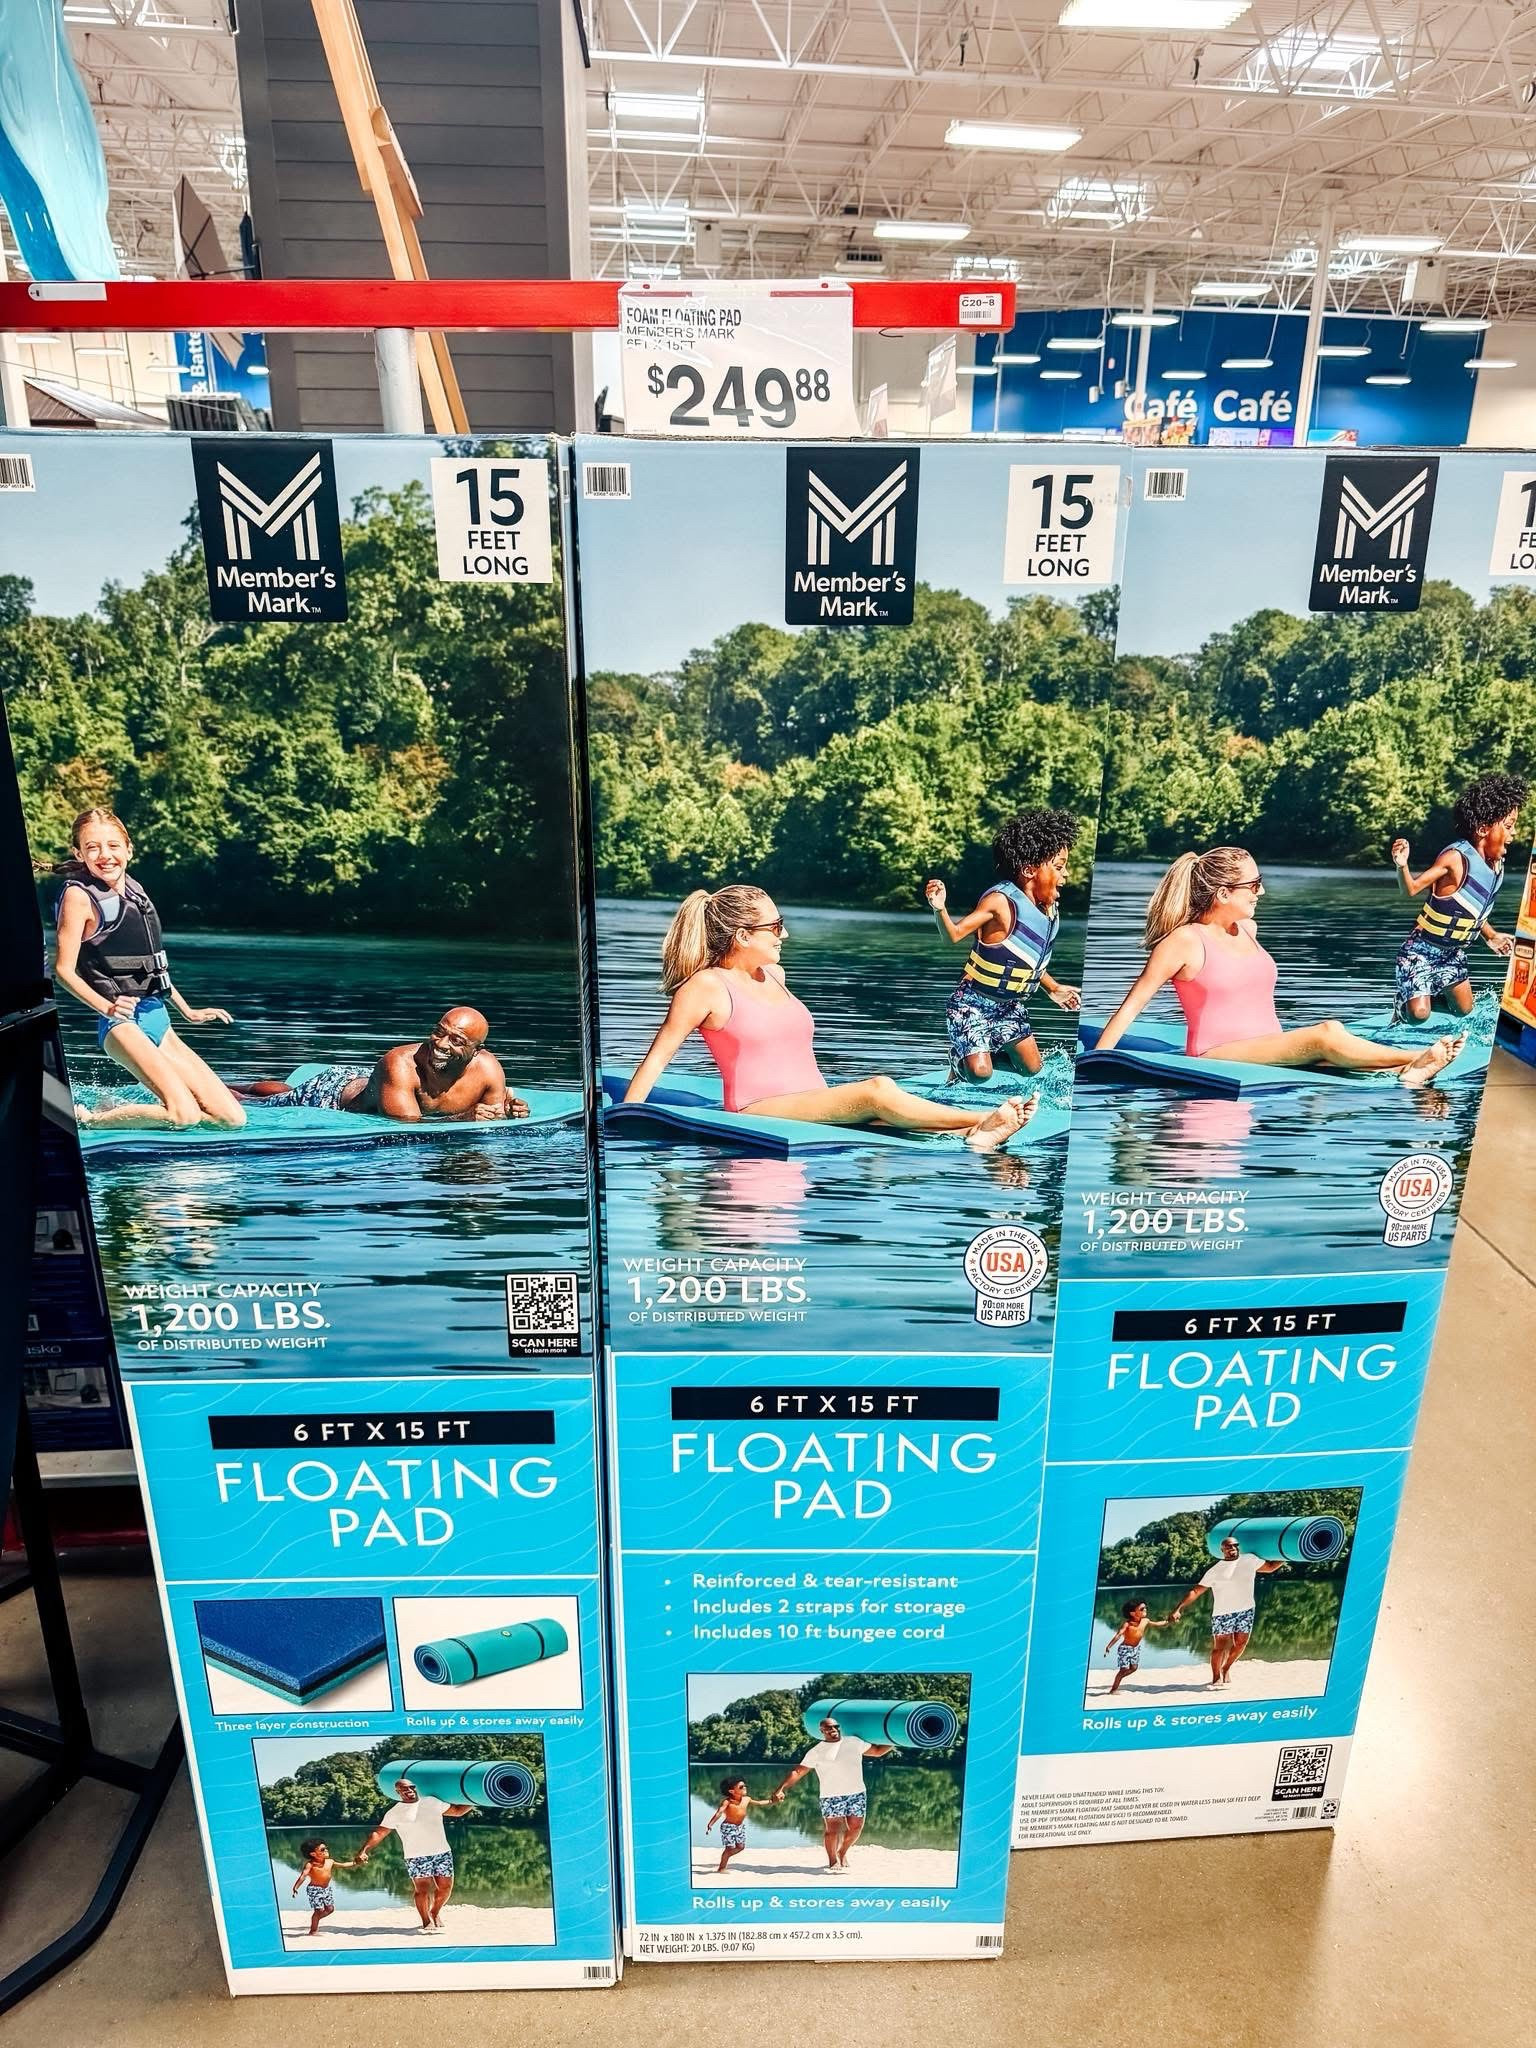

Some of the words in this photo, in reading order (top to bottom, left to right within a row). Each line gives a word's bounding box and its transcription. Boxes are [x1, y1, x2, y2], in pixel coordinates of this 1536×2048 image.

[962, 299, 995, 307] C20-8
[627, 307, 658, 325] FOAM
[720, 309, 741, 327] PAD
[627, 326, 694, 338] MEMBER'S
[698, 328, 735, 339] MARK
[1124, 390, 1197, 421] Café
[1213, 389, 1292, 422] Café
[456, 467, 525, 526] 15
[1031, 474, 1094, 530] 15
[468, 530, 521, 551] FEET
[1035, 534, 1086, 553] FEET
[463, 555, 529, 576] LONG
[1027, 557, 1090, 577] LONG
[1510, 553, 1536, 570] LO
[217, 565, 336, 589] Member's
[793, 570, 906, 593] Member's
[1319, 563, 1417, 583] Member's
[1389, 1161, 1409, 1182] MADE
[1411, 1158, 1420, 1166] IN
[1422, 1158, 1438, 1167] THE
[1436, 1165, 1447, 1180] USA
[1399, 1178, 1433, 1197] USA
[1080, 1191, 1156, 1206] WEIGHT
[1161, 1190, 1250, 1205] CAPACITY
[1384, 1194, 1409, 1217] FACTORY
[1411, 1191, 1446, 1217] CERTIFIED
[1083, 1208, 1173, 1240] 1,200
[1185, 1207, 1249, 1234] LBS.
[972, 1233, 994, 1255] MADE
[995, 1230, 1006, 1238] IN
[1009, 1230, 1027, 1241] THE
[1026, 1238, 1041, 1255] USA
[1080, 1241, 1099, 1252] OF
[1102, 1241, 1187, 1252] DISTRIBUTED
[1190, 1240, 1244, 1250] WEIGHT
[1388, 1231, 1400, 1242] US
[1400, 1230, 1427, 1241] PARTS
[623, 1257, 705, 1273] WEIGHT
[710, 1257, 807, 1273] CAPACITY
[986, 1252, 1026, 1273] USA
[122, 1283, 212, 1300] WEIGHT
[218, 1281, 320, 1298] CAPACITY
[970, 1268, 1002, 1295] FACTORY
[1003, 1268, 1042, 1295] CERTIFIED
[627, 1276, 727, 1310] 1,200
[740, 1276, 812, 1304] LBS.
[131, 1302, 239, 1338] 1,200
[252, 1300, 331, 1330] LBS.
[628, 1311, 648, 1322] OF
[652, 1311, 745, 1322] DISTRIBUTED
[748, 1311, 807, 1322] WEIGHT
[981, 1310, 993, 1321] US
[995, 1310, 1026, 1321] PARTS
[1185, 1318, 1198, 1334] 6
[1208, 1317, 1238, 1333] FT
[1246, 1316, 1263, 1333] X
[1272, 1315, 1297, 1332] 15
[1306, 1313, 1336, 1330] FT
[137, 1339, 160, 1351] OF
[163, 1338, 262, 1350] DISTRIBUTED
[266, 1337, 328, 1349] WEIGHT
[511, 1338, 545, 1348] SCAN
[547, 1338, 578, 1347] HERE
[1107, 1343, 1397, 1391] FLOATING
[750, 1395, 764, 1414] 6
[777, 1395, 809, 1413] FT
[819, 1395, 837, 1413] X
[848, 1395, 874, 1413] 15
[887, 1395, 919, 1413] FT
[1194, 1391, 1301, 1431] PAD
[293, 1423, 309, 1442] 6
[321, 1422, 355, 1441] FT
[366, 1421, 385, 1441] X
[395, 1420, 425, 1440] 15
[437, 1420, 471, 1440] FT
[672, 1431, 998, 1474] FLOATING
[215, 1456, 558, 1504] FLOATING
[774, 1479, 892, 1520] PAD
[329, 1506, 455, 1548] PAD
[692, 1573, 797, 1589] Reinforced
[803, 1574, 819, 1589] &
[824, 1575, 958, 1589] tear-resistant
[692, 1599, 772, 1615] Includes
[778, 1599, 790, 1614] 2
[795, 1600, 854, 1618] straps
[861, 1598, 888, 1614] for
[894, 1601, 966, 1618] storage
[693, 1624, 772, 1640] Includes
[778, 1624, 799, 1639] 10
[804, 1624, 822, 1639] ft
[827, 1624, 897, 1643] bungee
[902, 1624, 945, 1640] cord
[215, 1721, 252, 1732] Three
[255, 1720, 286, 1733] layer
[289, 1719, 370, 1730] construction
[406, 1716, 436, 1727] Rolls
[440, 1718, 456, 1728] up
[460, 1716, 470, 1726] &
[472, 1716, 511, 1726] stores
[515, 1717, 546, 1728] away
[549, 1715, 585, 1727] easily
[1082, 1718, 1122, 1731] Rolls
[1127, 1718, 1148, 1731] up
[1152, 1714, 1166, 1727] &
[1170, 1712, 1223, 1726] stores
[1226, 1710, 1268, 1724] away
[1272, 1704, 1318, 1720] easily
[1274, 1788, 1299, 1796] SCAN
[1300, 1785, 1323, 1794] HERE
[692, 1896, 735, 1909] Rolls
[740, 1898, 764, 1912] up
[768, 1896, 783, 1909] &
[788, 1897, 845, 1909] stores
[850, 1898, 894, 1911] away
[900, 1895, 951, 1911] easily
[640, 1932, 649, 1942] 72
[651, 1933, 660, 1942] IN
[670, 1933, 685, 1942] 180
[686, 1932, 695, 1941] IN
[706, 1932, 726, 1941] 1.375
[728, 1932, 737, 1941] IN
[738, 1931, 767, 1941] (182.88
[769, 1932, 781, 1940] cm
[783, 1932, 788, 1940] x
[789, 1931, 810, 1940] 457.2
[811, 1932, 824, 1940] cm
[832, 1931, 844, 1940] 3.5
[846, 1930, 863, 1940] cm).
[640, 1944, 654, 1954] NET
[656, 1944, 689, 1954] WEIGHT:
[691, 1943, 701, 1953] 20
[702, 1943, 719, 1952] LBS.
[721, 1943, 740, 1953] (9.07
[741, 1942, 756, 1952] KG)
